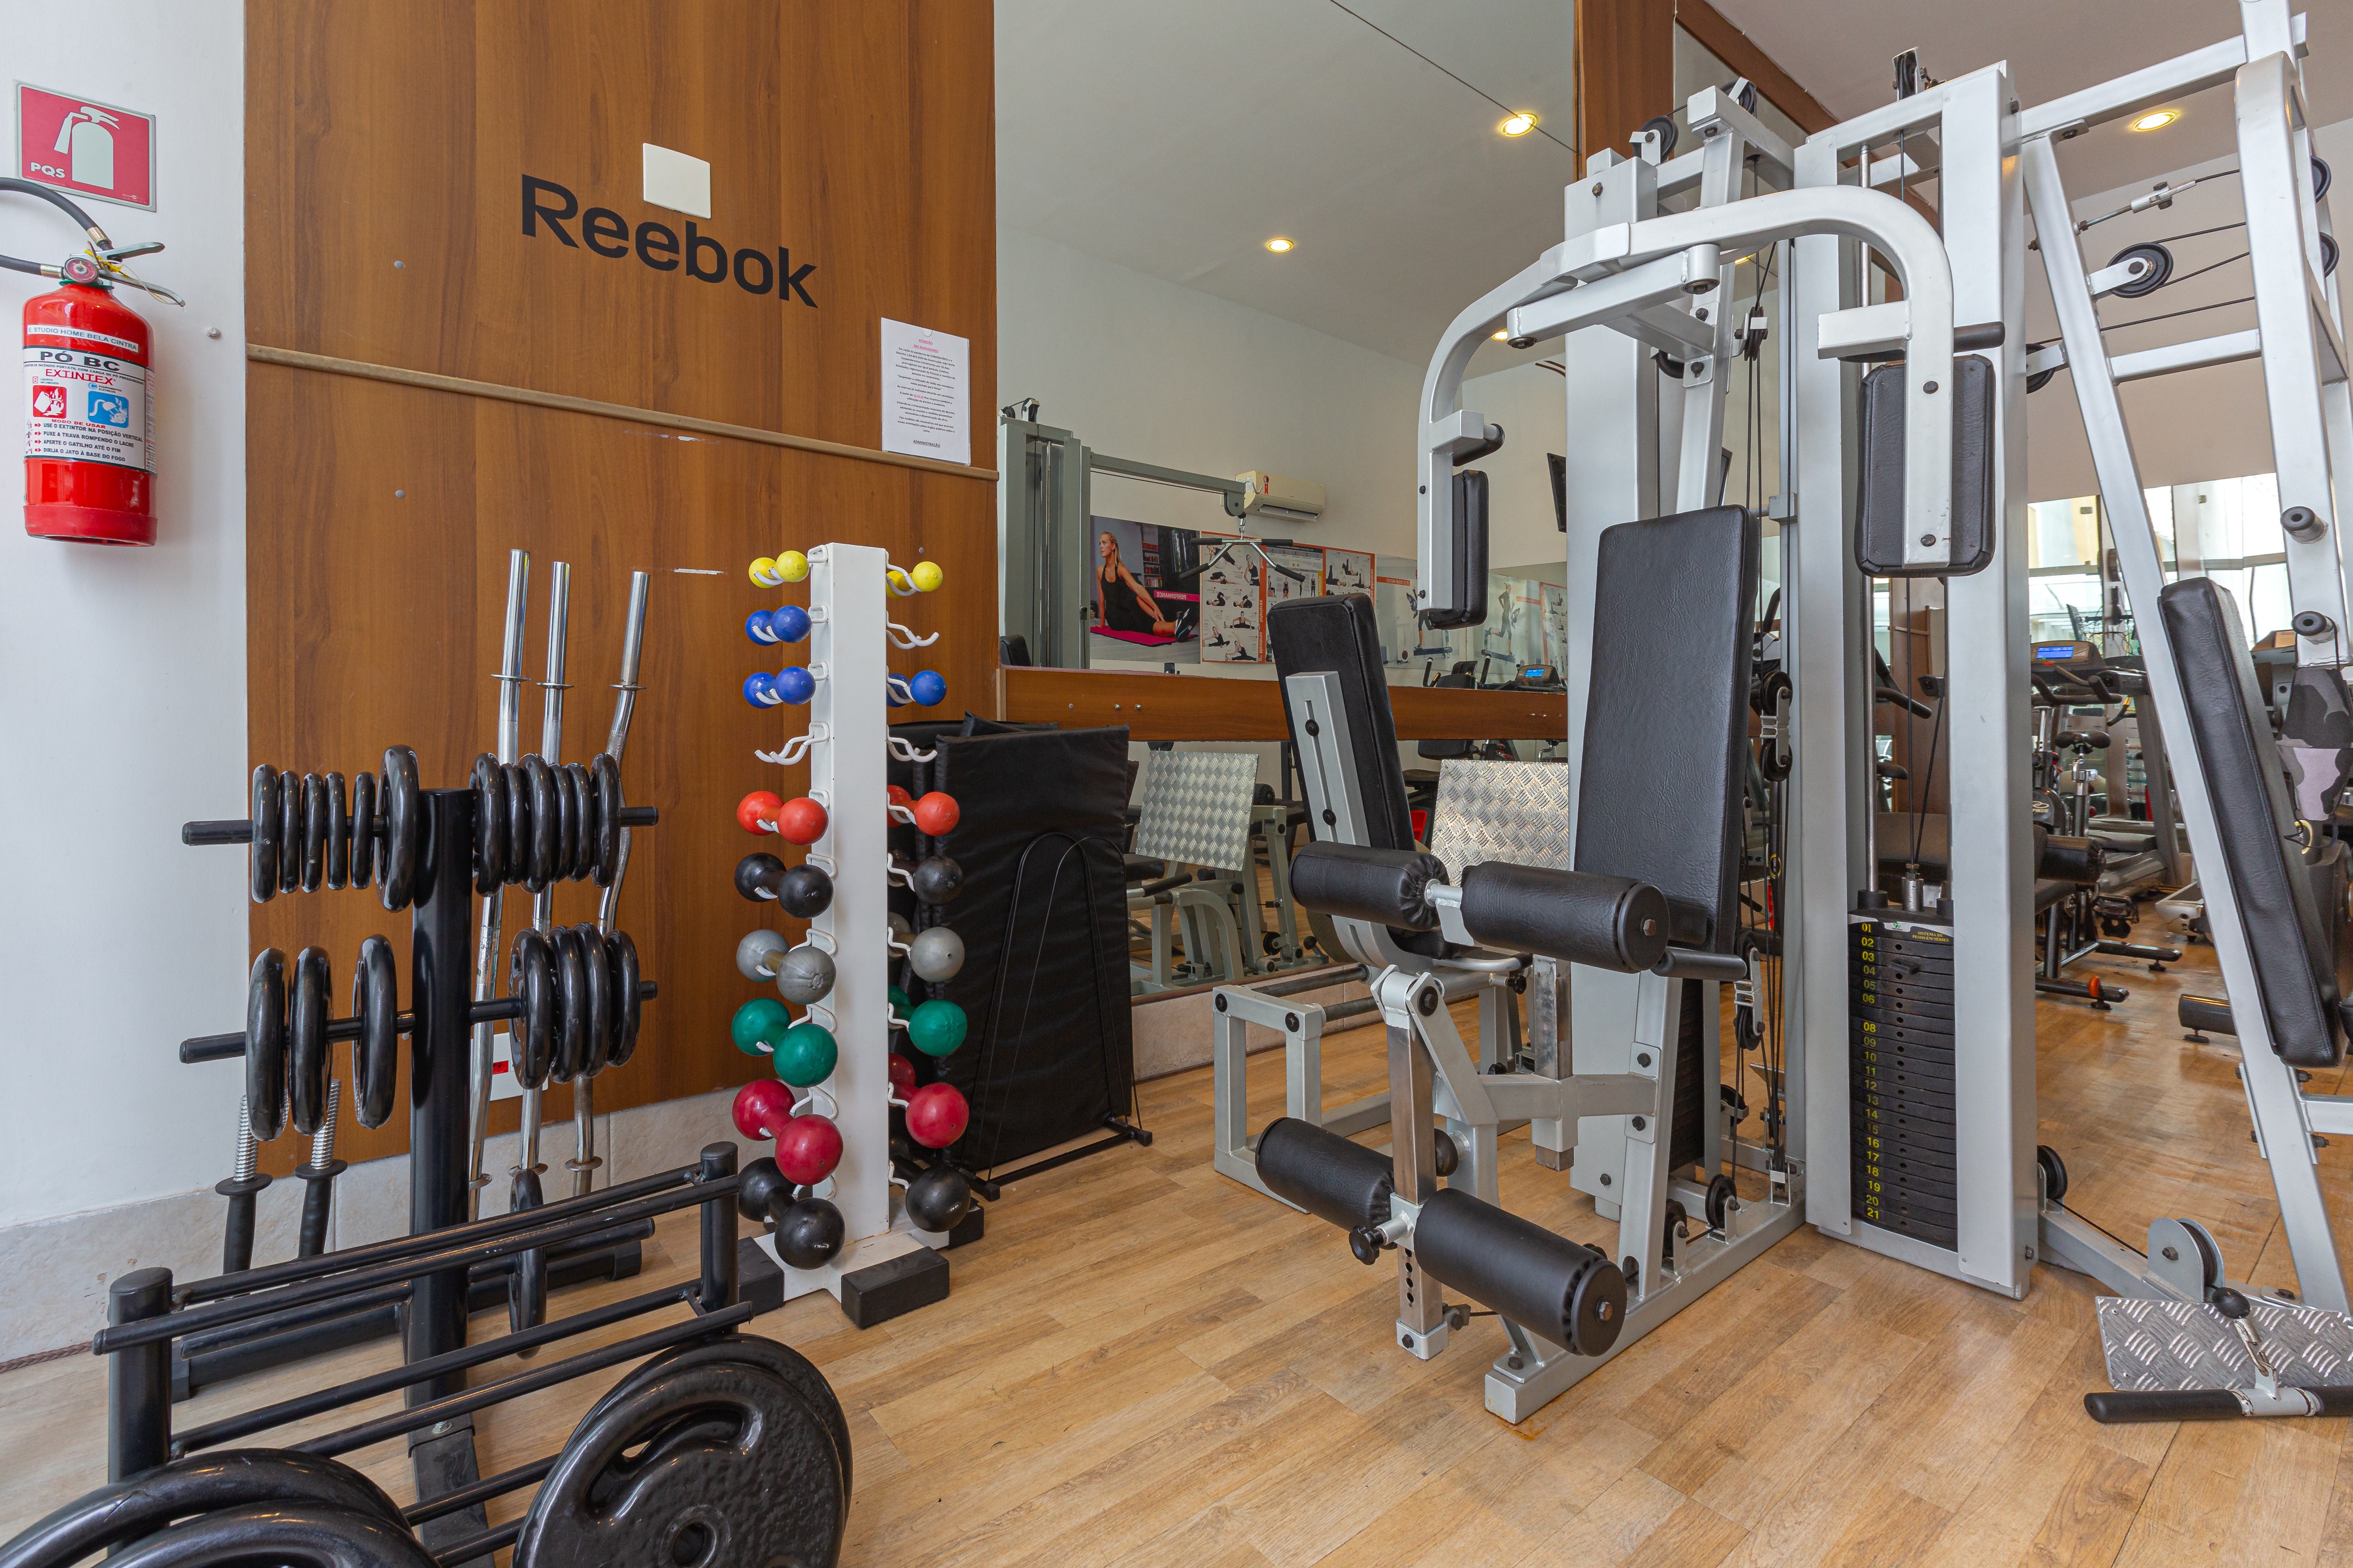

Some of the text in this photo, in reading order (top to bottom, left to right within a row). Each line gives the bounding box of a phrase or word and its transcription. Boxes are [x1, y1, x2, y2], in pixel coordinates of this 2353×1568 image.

[31, 162, 65, 178] PQS
[522, 174, 819, 308] Reebok
[61, 329, 84, 337] HOME
[87, 333, 109, 342] BELA
[111, 338, 137, 350] CINTRA
[41, 351, 120, 372] PÓ BC
[82, 435, 112, 443] ROMPENDO
[98, 429, 121, 437] POSIÇÃO
[123, 434, 143, 442] VERTICAL
[1862, 923, 1871, 932] 01
[1861, 937, 1874, 947] 02
[1862, 951, 1874, 961] 03
[1863, 966, 1876, 975] 04
[1864, 980, 1876, 990] 05
[1863, 994, 1875, 1004] 06
[1864, 1022, 1876, 1032] 08
[1864, 1036, 1876, 1047] 09
[1865, 1052, 1876, 1062] 10
[1866, 1066, 1876, 1076] 11
[1865, 1079, 1877, 1091] 12
[1867, 1094, 1879, 1105] 13
[1866, 1109, 1878, 1119] 14
[1867, 1123, 1878, 1134] 15
[1867, 1137, 1879, 1148] 16
[1867, 1151, 1879, 1161] 17
[1867, 1165, 1879, 1177] 18
[1868, 1181, 1880, 1192] 19
[1866, 1194, 1879, 1206] 20
[1867, 1207, 1879, 1219] 21
